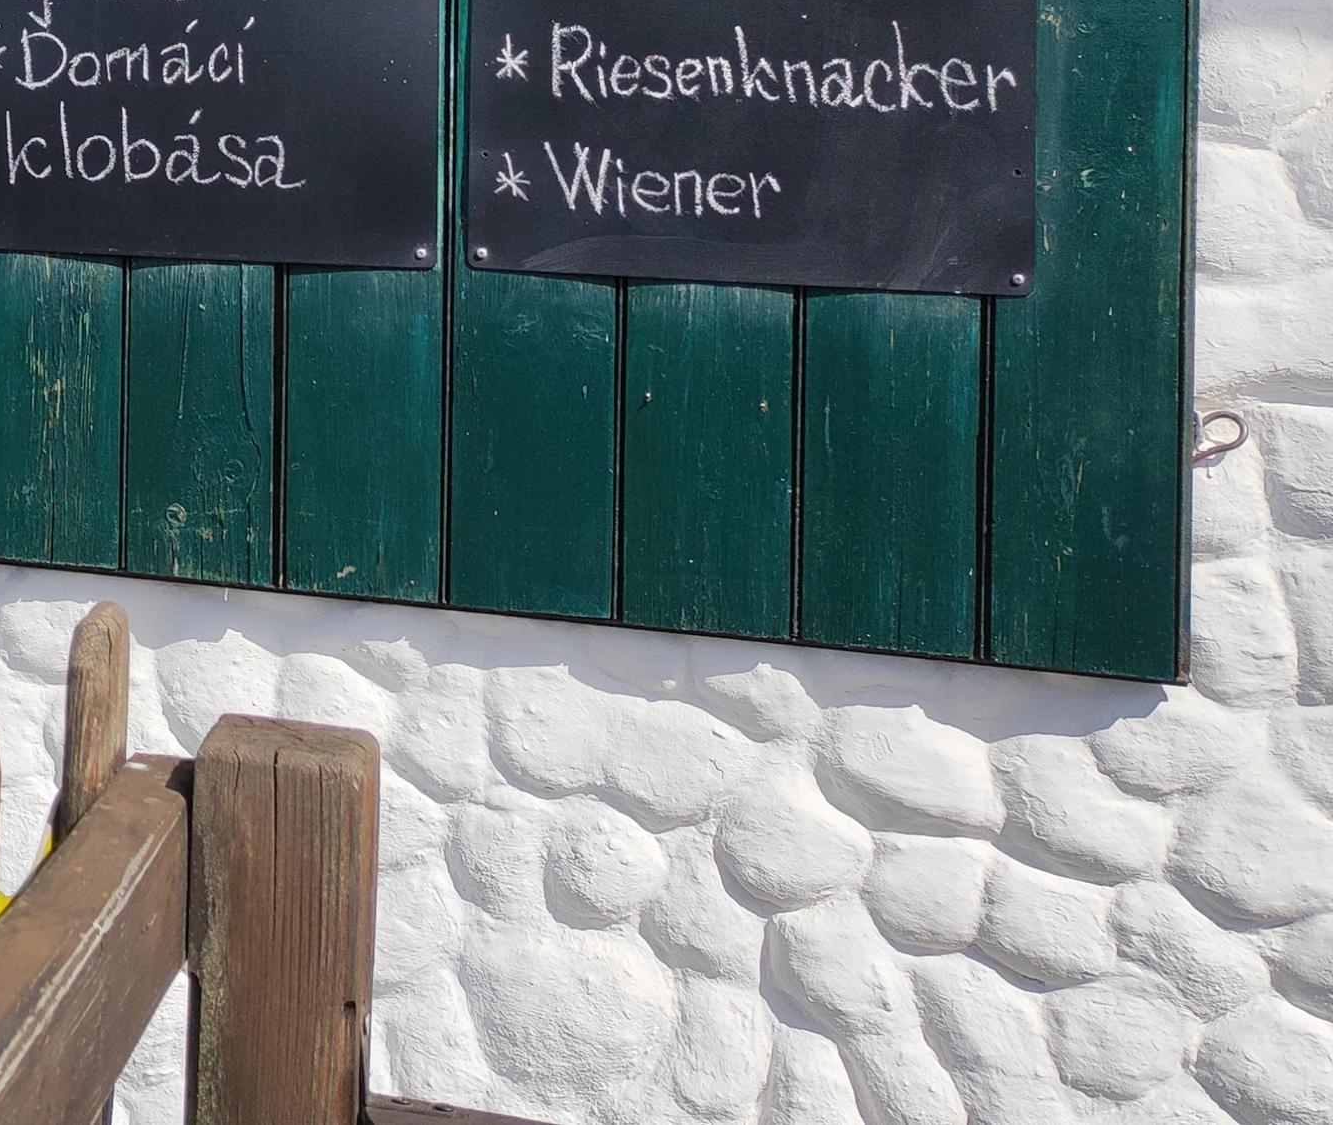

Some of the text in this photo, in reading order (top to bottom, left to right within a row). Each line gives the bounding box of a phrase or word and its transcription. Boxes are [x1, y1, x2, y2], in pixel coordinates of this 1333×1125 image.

[14, 16, 256, 91] Domácí
[549, 19, 1018, 115] Riesenknacker
[5, 100, 307, 191] klobása
[544, 141, 782, 220] Wiener
